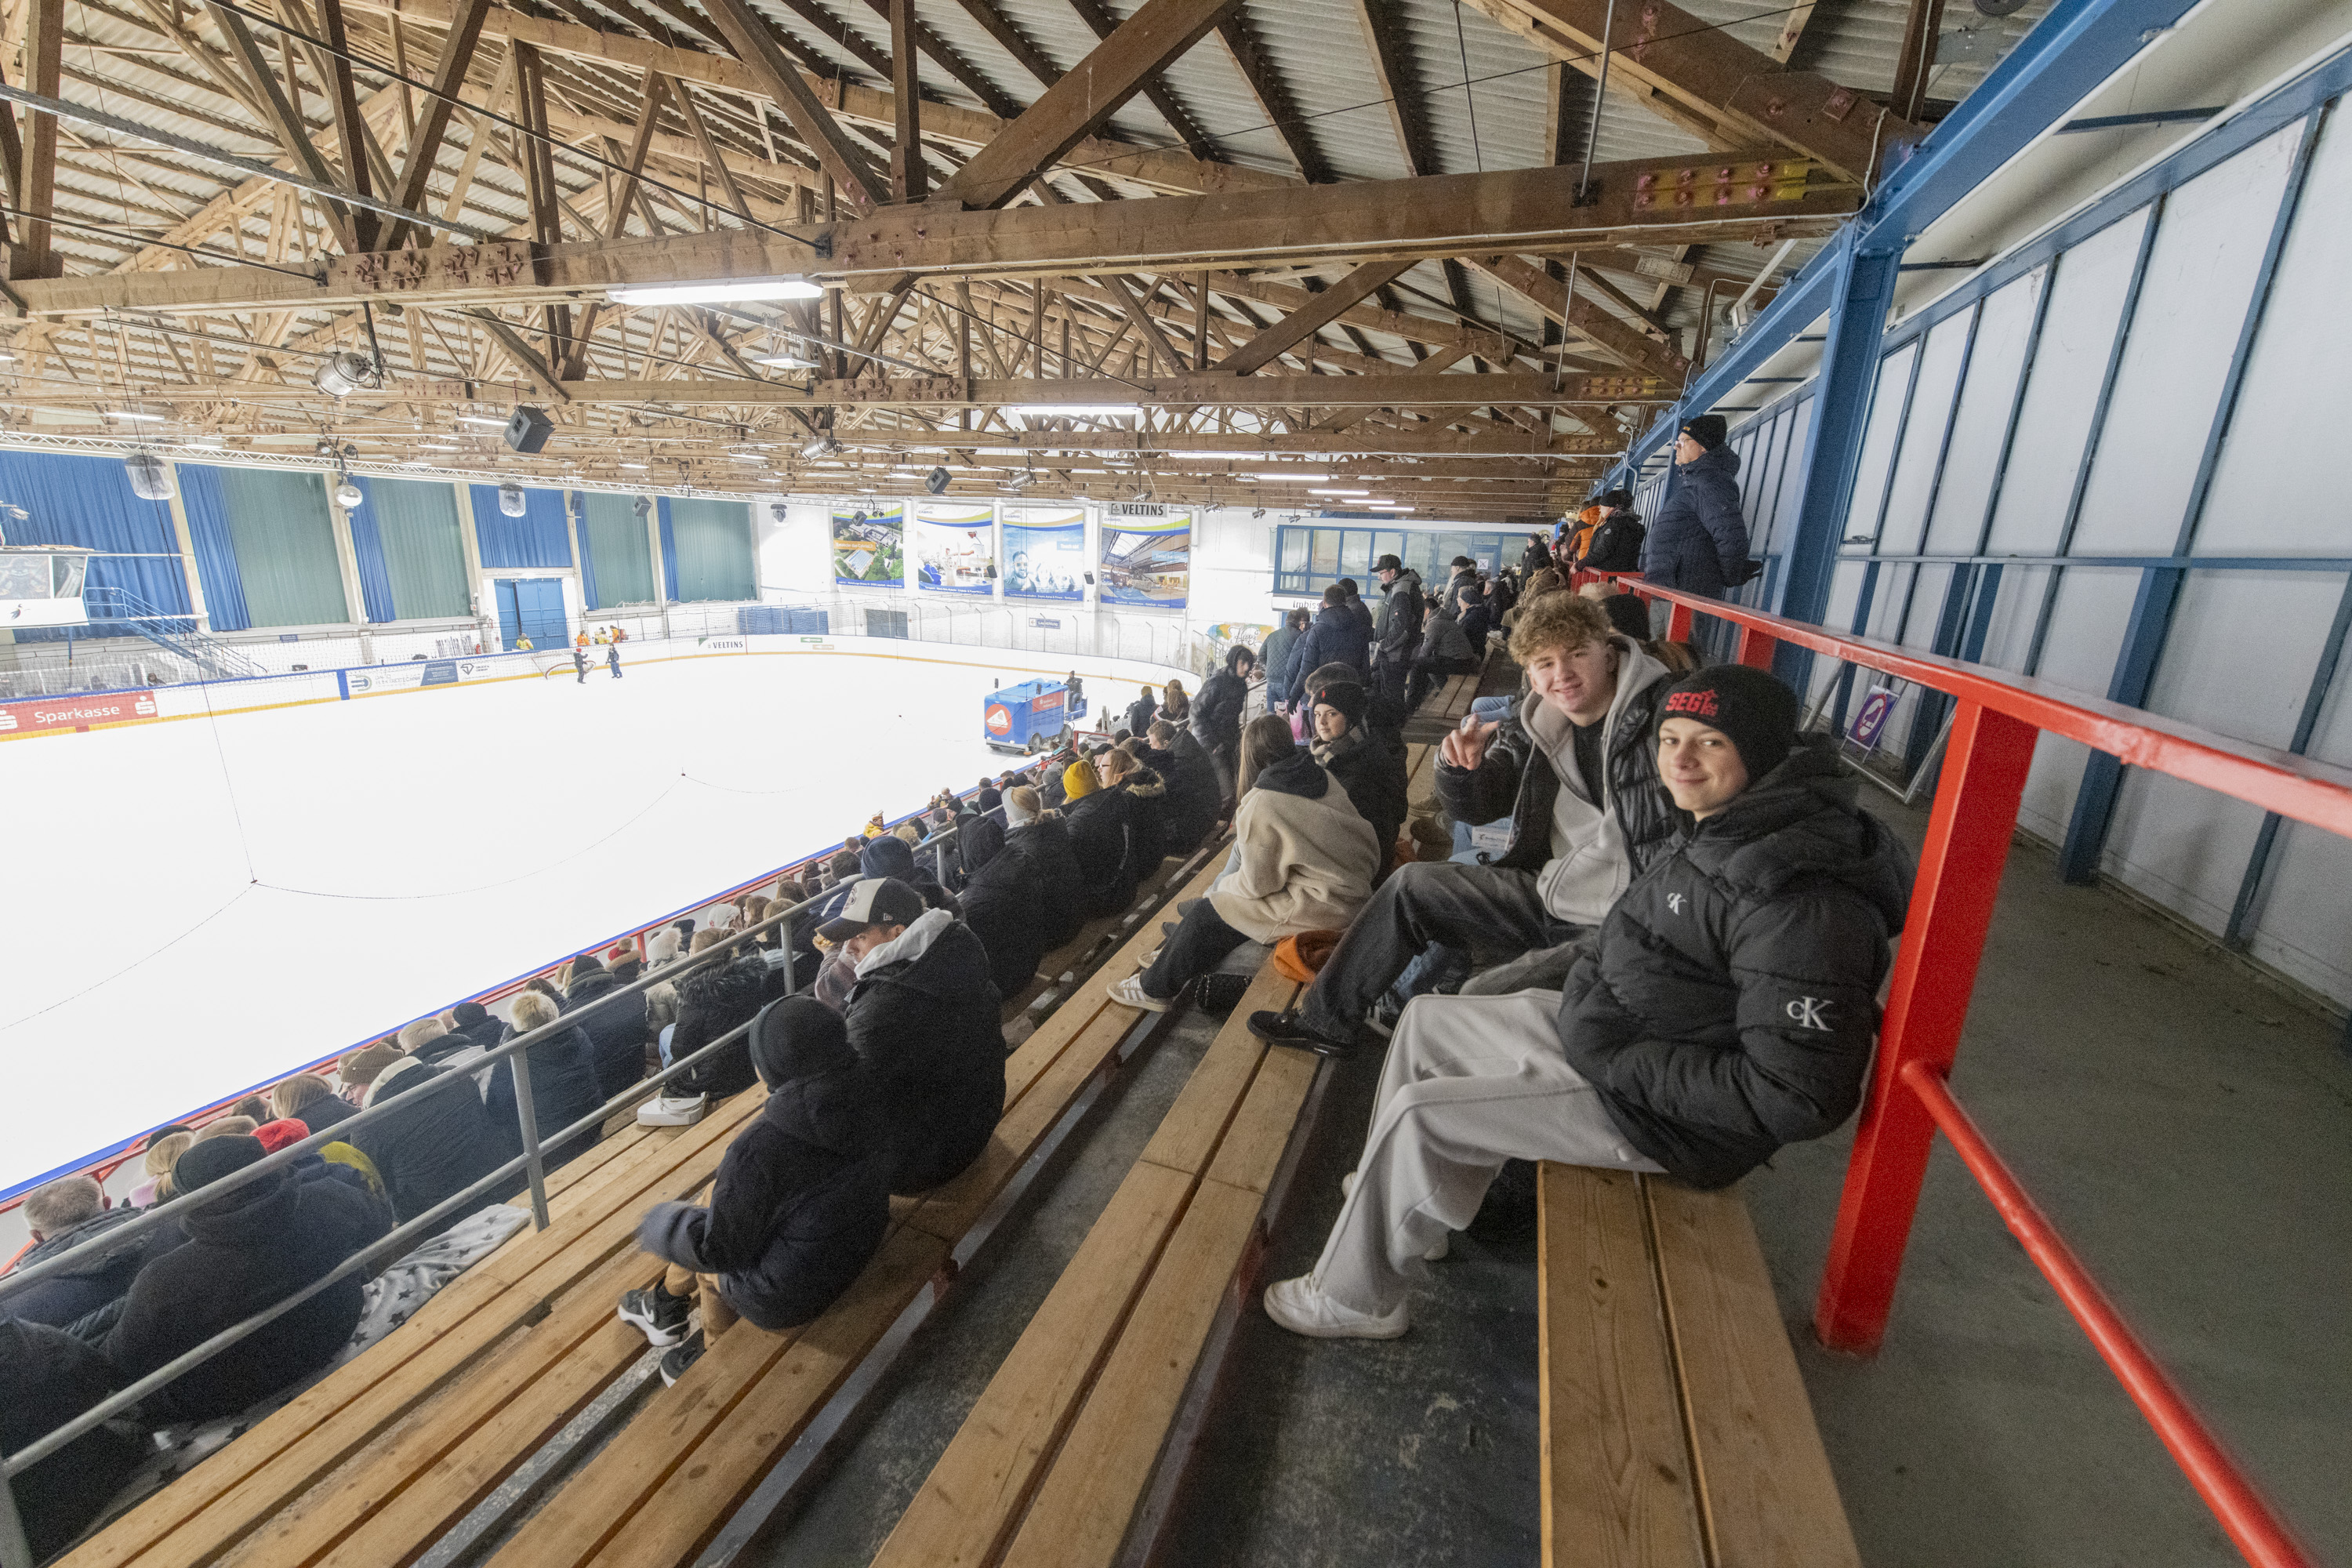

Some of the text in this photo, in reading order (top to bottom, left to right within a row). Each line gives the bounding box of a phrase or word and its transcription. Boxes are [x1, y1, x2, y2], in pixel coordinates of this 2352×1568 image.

[1122, 504, 1163, 516] VELTINS
[713, 641, 743, 649] VELTINS
[34, 706, 120, 724] Sparkasse
